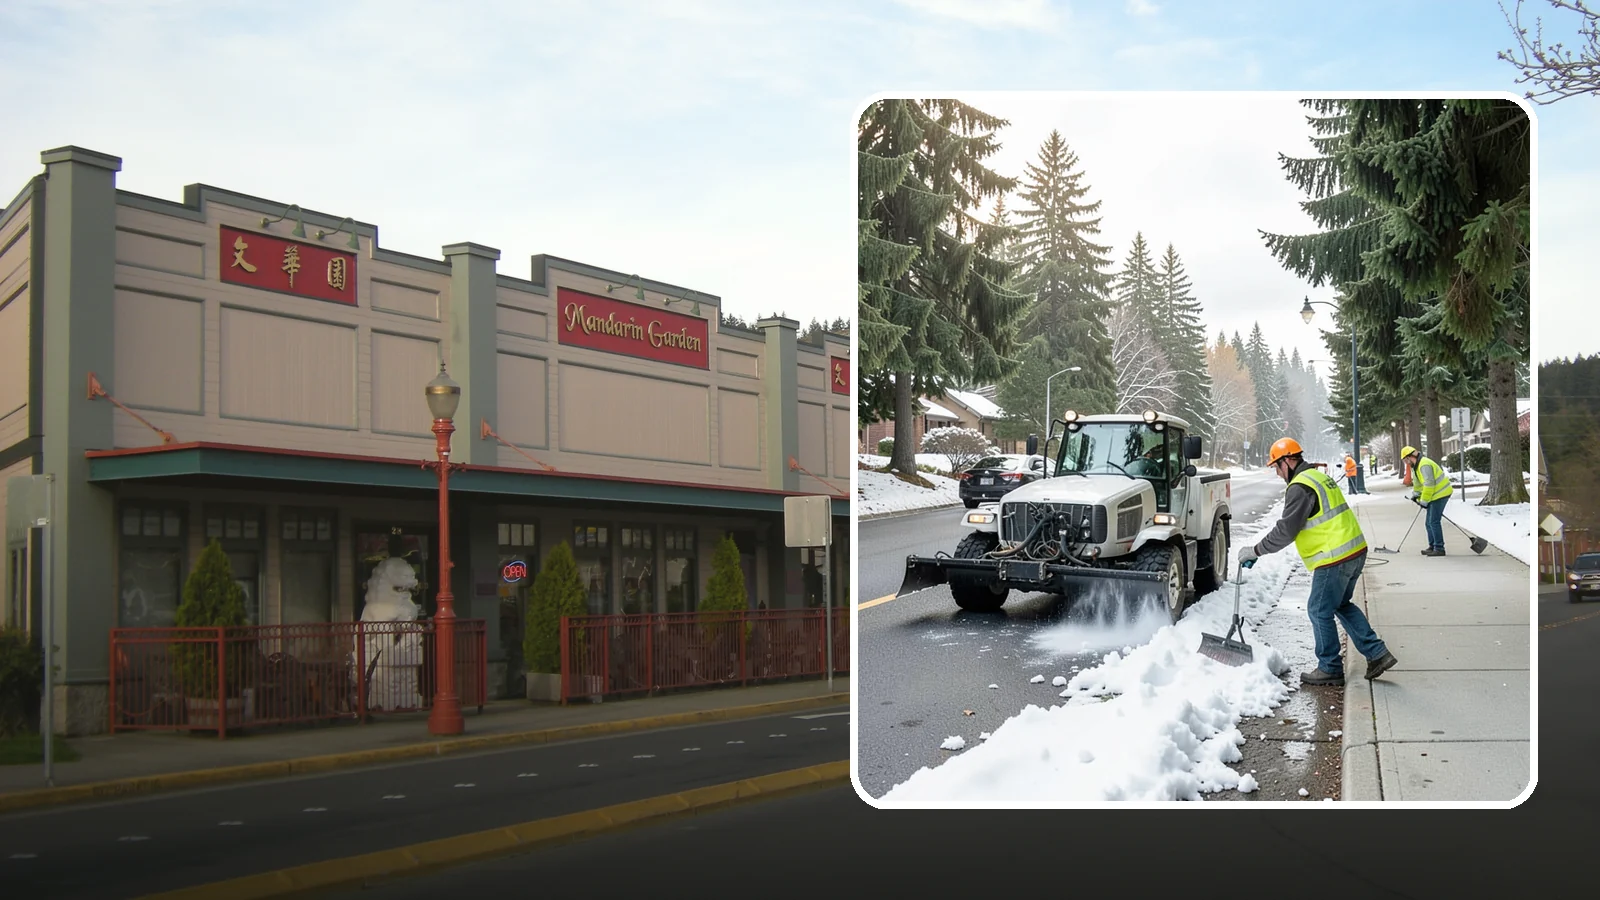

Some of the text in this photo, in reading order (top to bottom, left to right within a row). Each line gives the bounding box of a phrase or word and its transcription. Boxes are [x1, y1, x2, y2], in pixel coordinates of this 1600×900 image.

[231, 236, 346, 290] 文華園
[564, 302, 701, 352] Mandarin Garden
[834, 363, 846, 386] 文
[503, 565, 526, 578] OPEN
